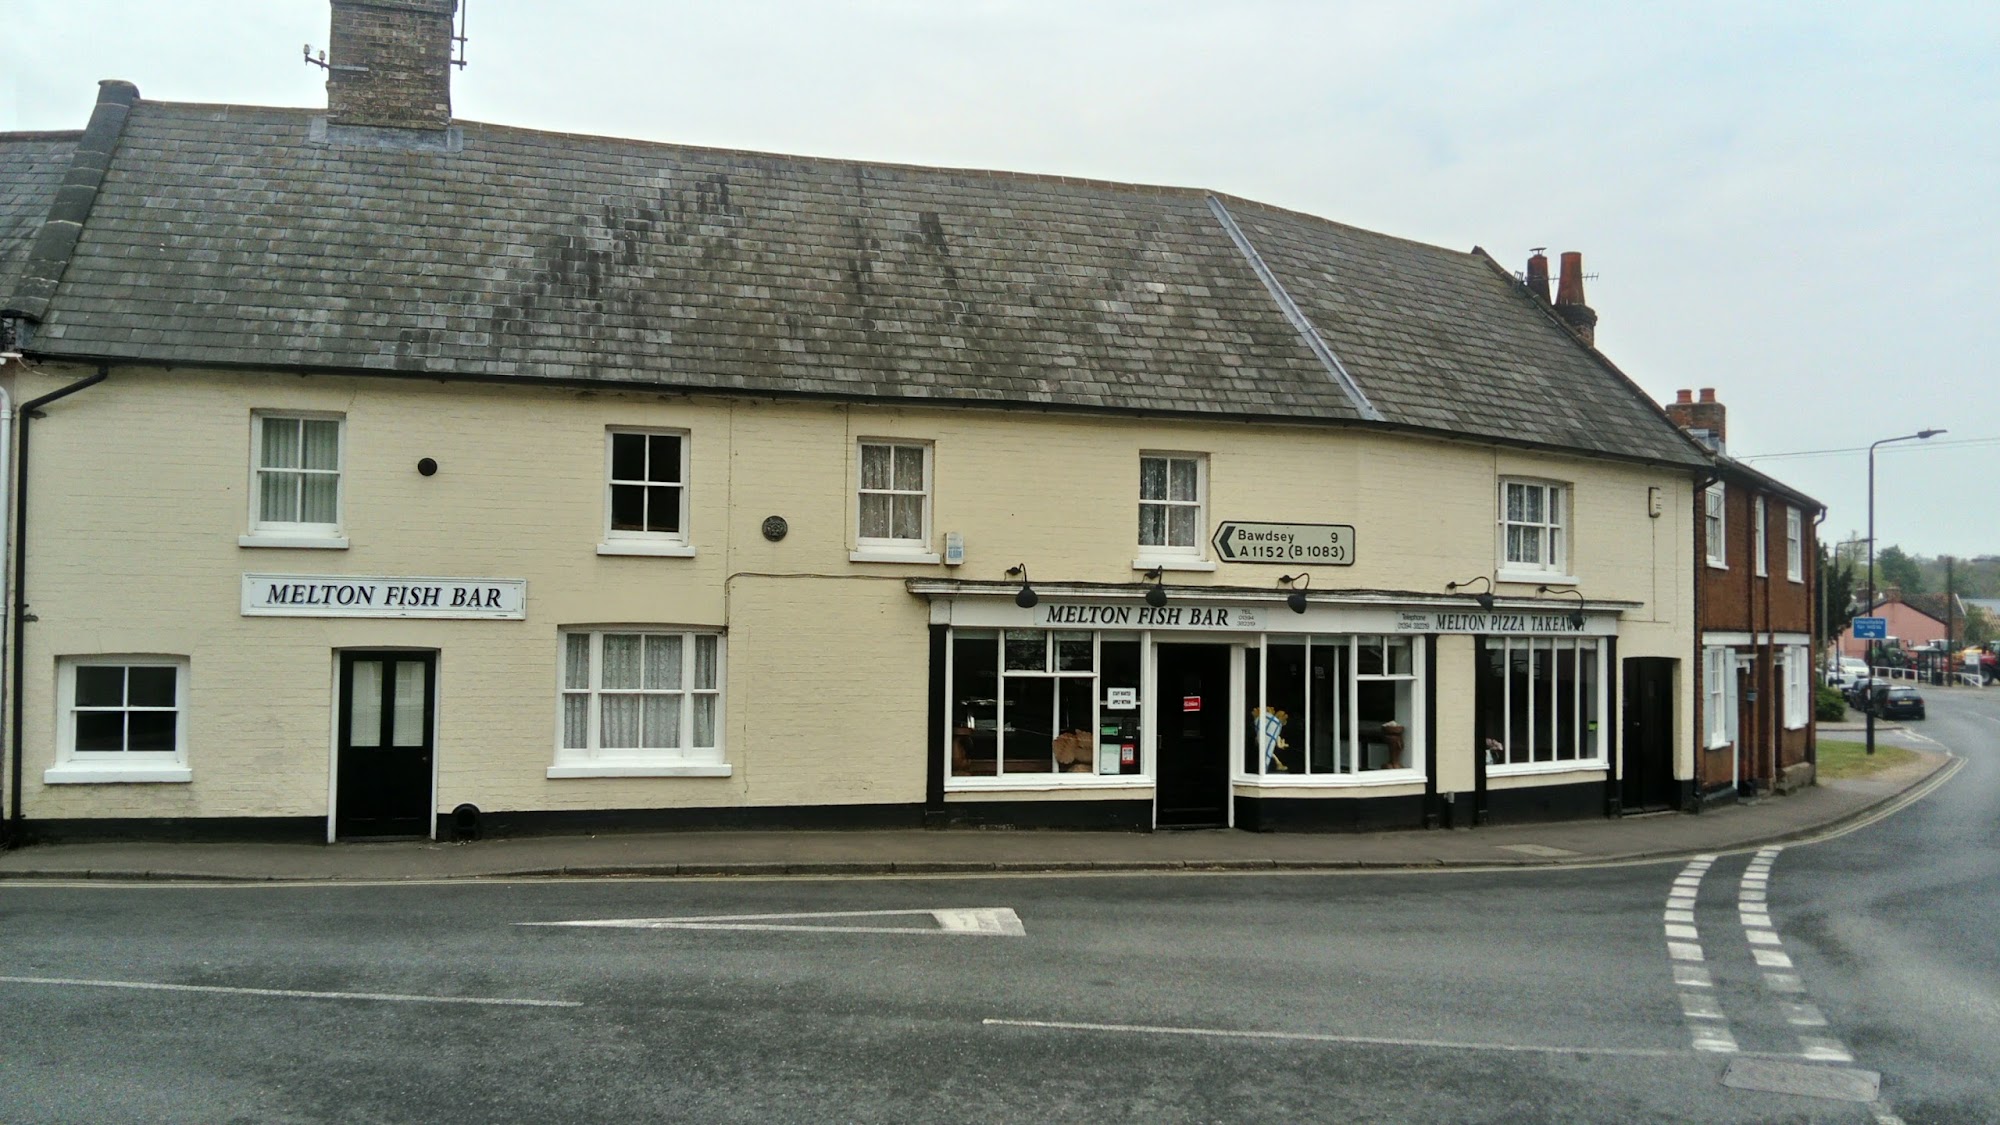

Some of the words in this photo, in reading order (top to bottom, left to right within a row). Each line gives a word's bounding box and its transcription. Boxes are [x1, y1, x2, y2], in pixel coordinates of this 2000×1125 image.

[1238, 529, 1294, 544] Bawdsey
[1331, 532, 1338, 543] 9
[266, 584, 376, 606] MELTON
[384, 585, 443, 606] FISH
[450, 587, 502, 608] BAR
[1047, 605, 1131, 624] MELTON
[1137, 607, 1183, 625] FISH
[1189, 608, 1229, 626] BAR
[1436, 614, 1486, 630] MELTON
[1491, 615, 1525, 631] PIZZA
